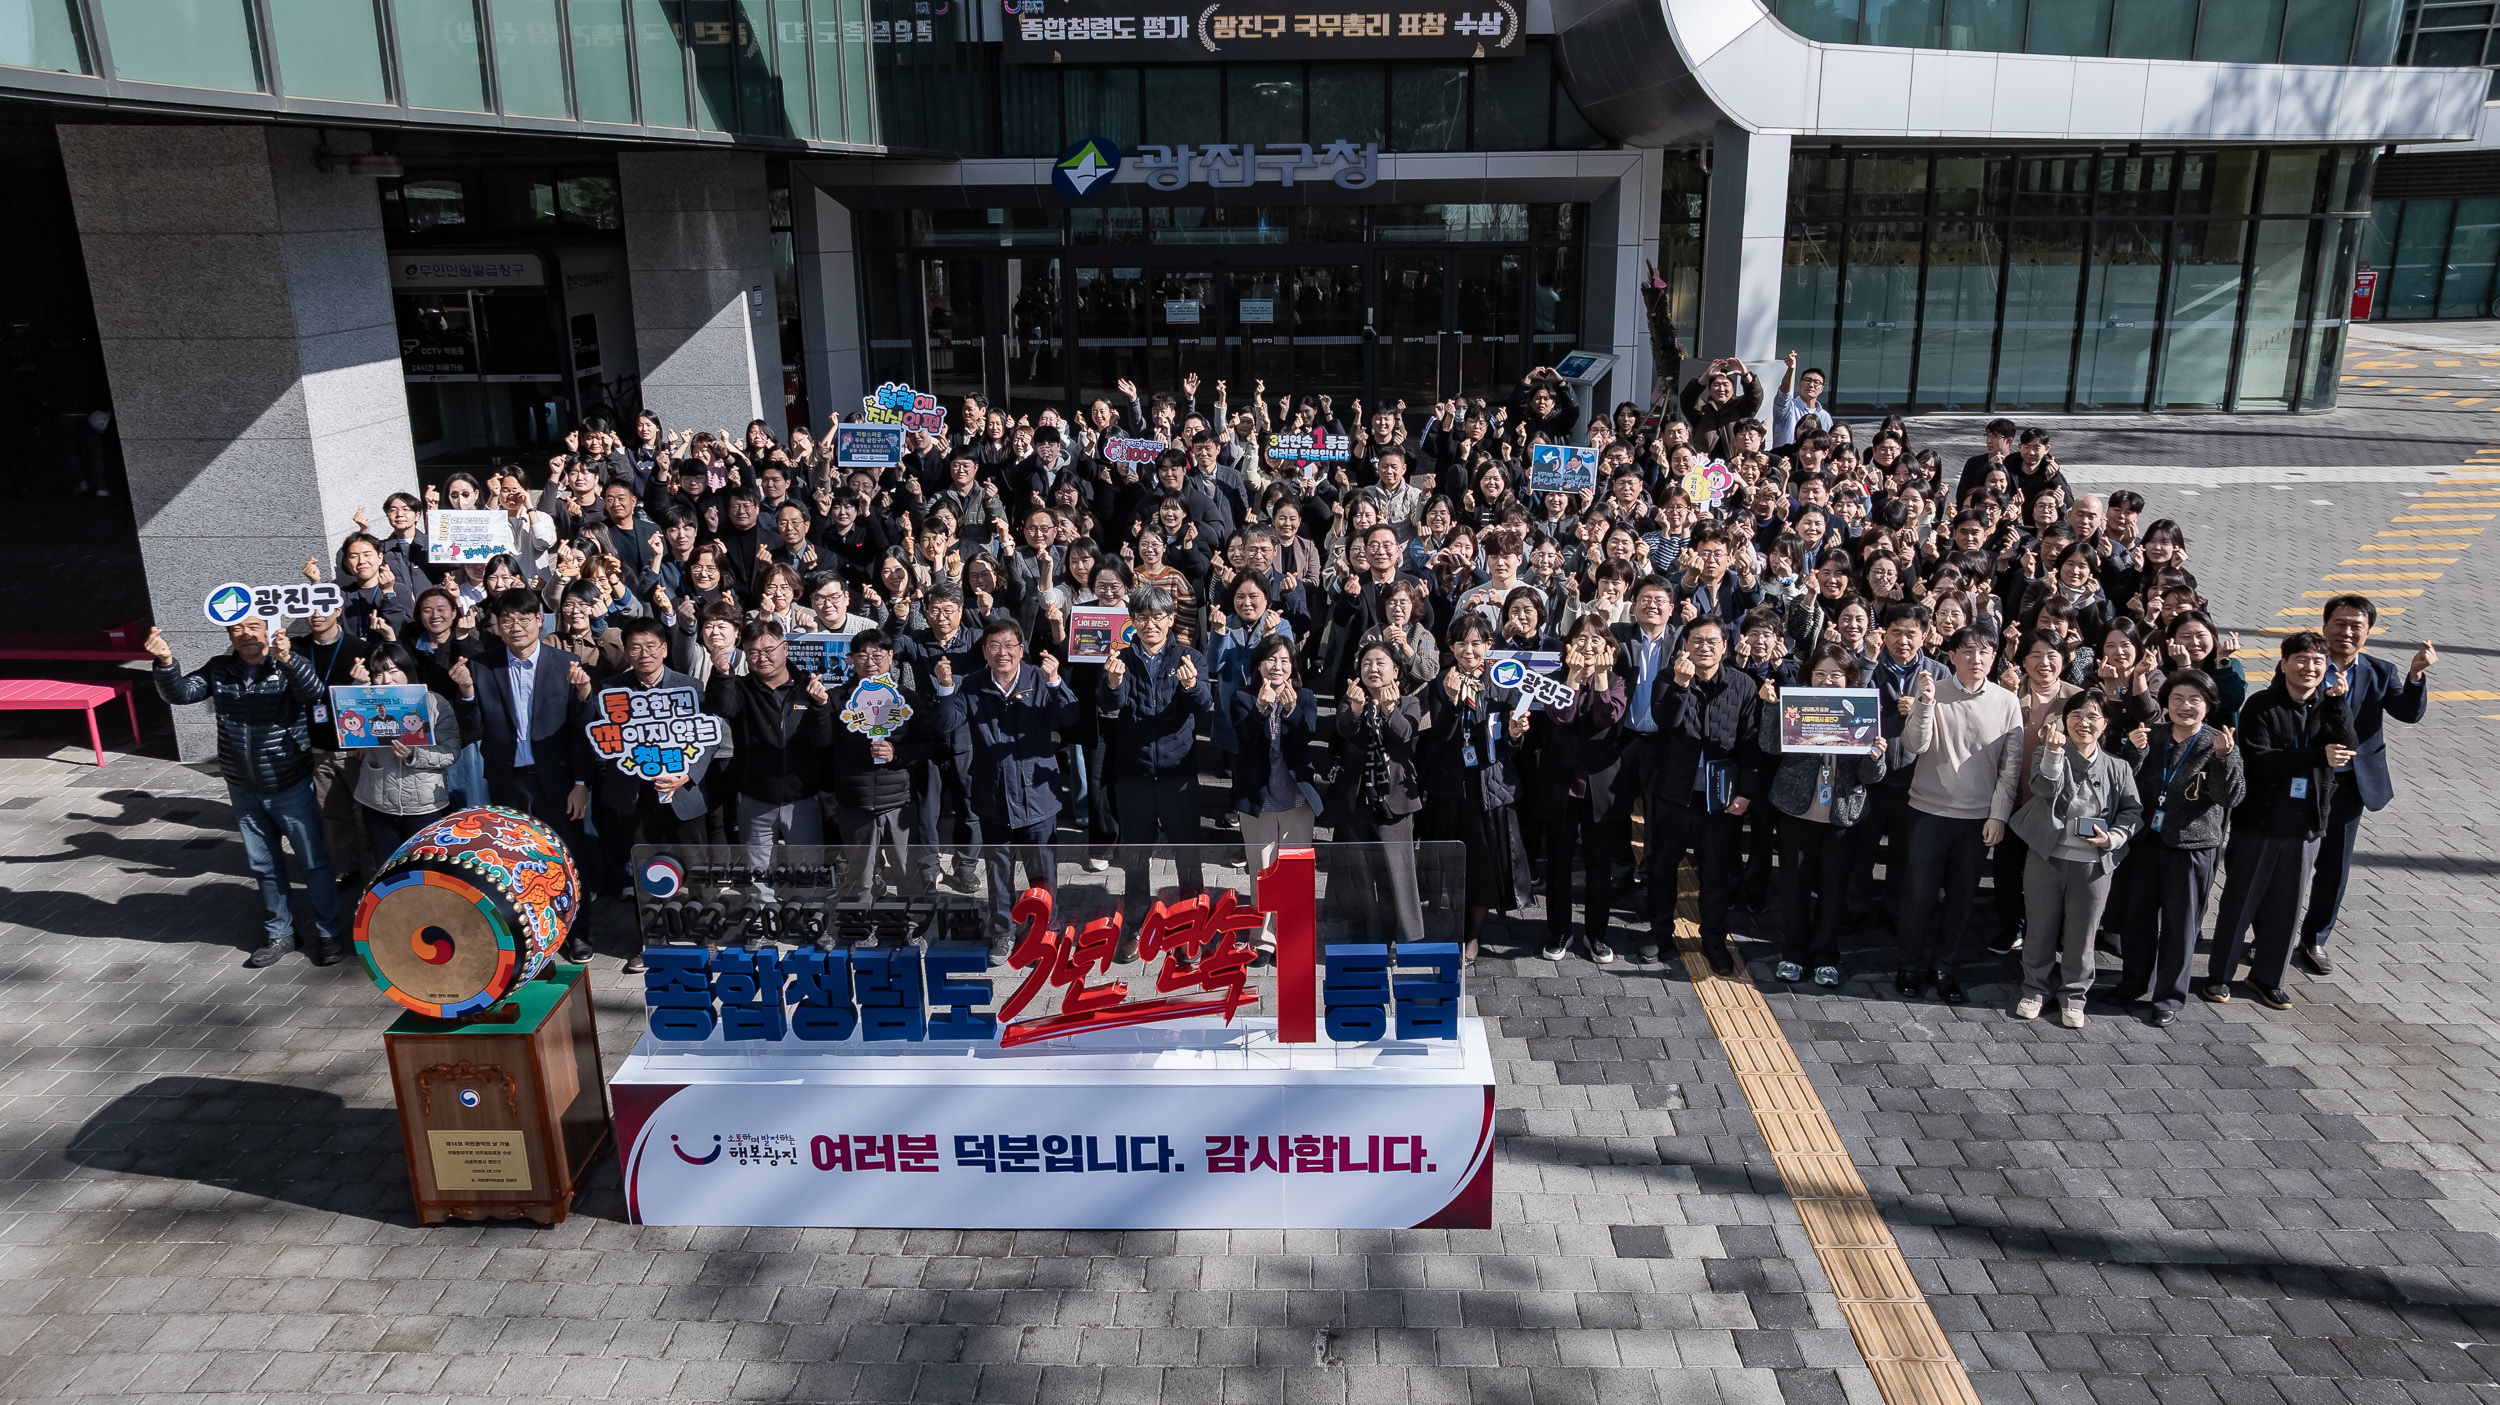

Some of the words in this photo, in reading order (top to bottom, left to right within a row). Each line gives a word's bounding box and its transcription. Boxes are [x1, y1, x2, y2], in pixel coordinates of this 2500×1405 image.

[1021, 17, 1137, 41] 종합청렴도
[1143, 16, 1190, 39] 평가
[1214, 14, 1286, 38] 광진구
[1295, 13, 1390, 38] 국무총리
[1398, 12, 1448, 37] 표창
[1454, 12, 1504, 36] 수상
[1133, 139, 1378, 190] 광진구청
[420, 264, 525, 278] 무인민원발급창구
[420, 347, 442, 356] CCTV
[879, 384, 934, 411] 청렴에
[1268, 448, 1298, 460] 여러분
[1300, 449, 1350, 461] 덕분입니다
[463, 545, 506, 559] 감사합니다
[255, 587, 339, 616] 광진구
[1521, 673, 1573, 707] 광진구
[888, 708, 902, 722] 듯
[592, 723, 669, 753] 꺾이지
[672, 719, 716, 742] 않는
[633, 745, 683, 776] 청렴
[689, 864, 836, 889] 국민권익위원회
[834, 900, 986, 942] 공공기관
[644, 943, 999, 1043] 종합청렴도
[1141, 888, 1264, 1027] 연속
[1322, 942, 1461, 1042] 등급
[728, 1132, 760, 1146] 소통하며
[760, 1133, 796, 1146] 발전하는
[728, 1145, 799, 1167] 행복광진
[810, 1134, 941, 1173] 여러분
[953, 1134, 1185, 1173] 덕분입니다.
[1205, 1134, 1437, 1173] 감사합니다.
